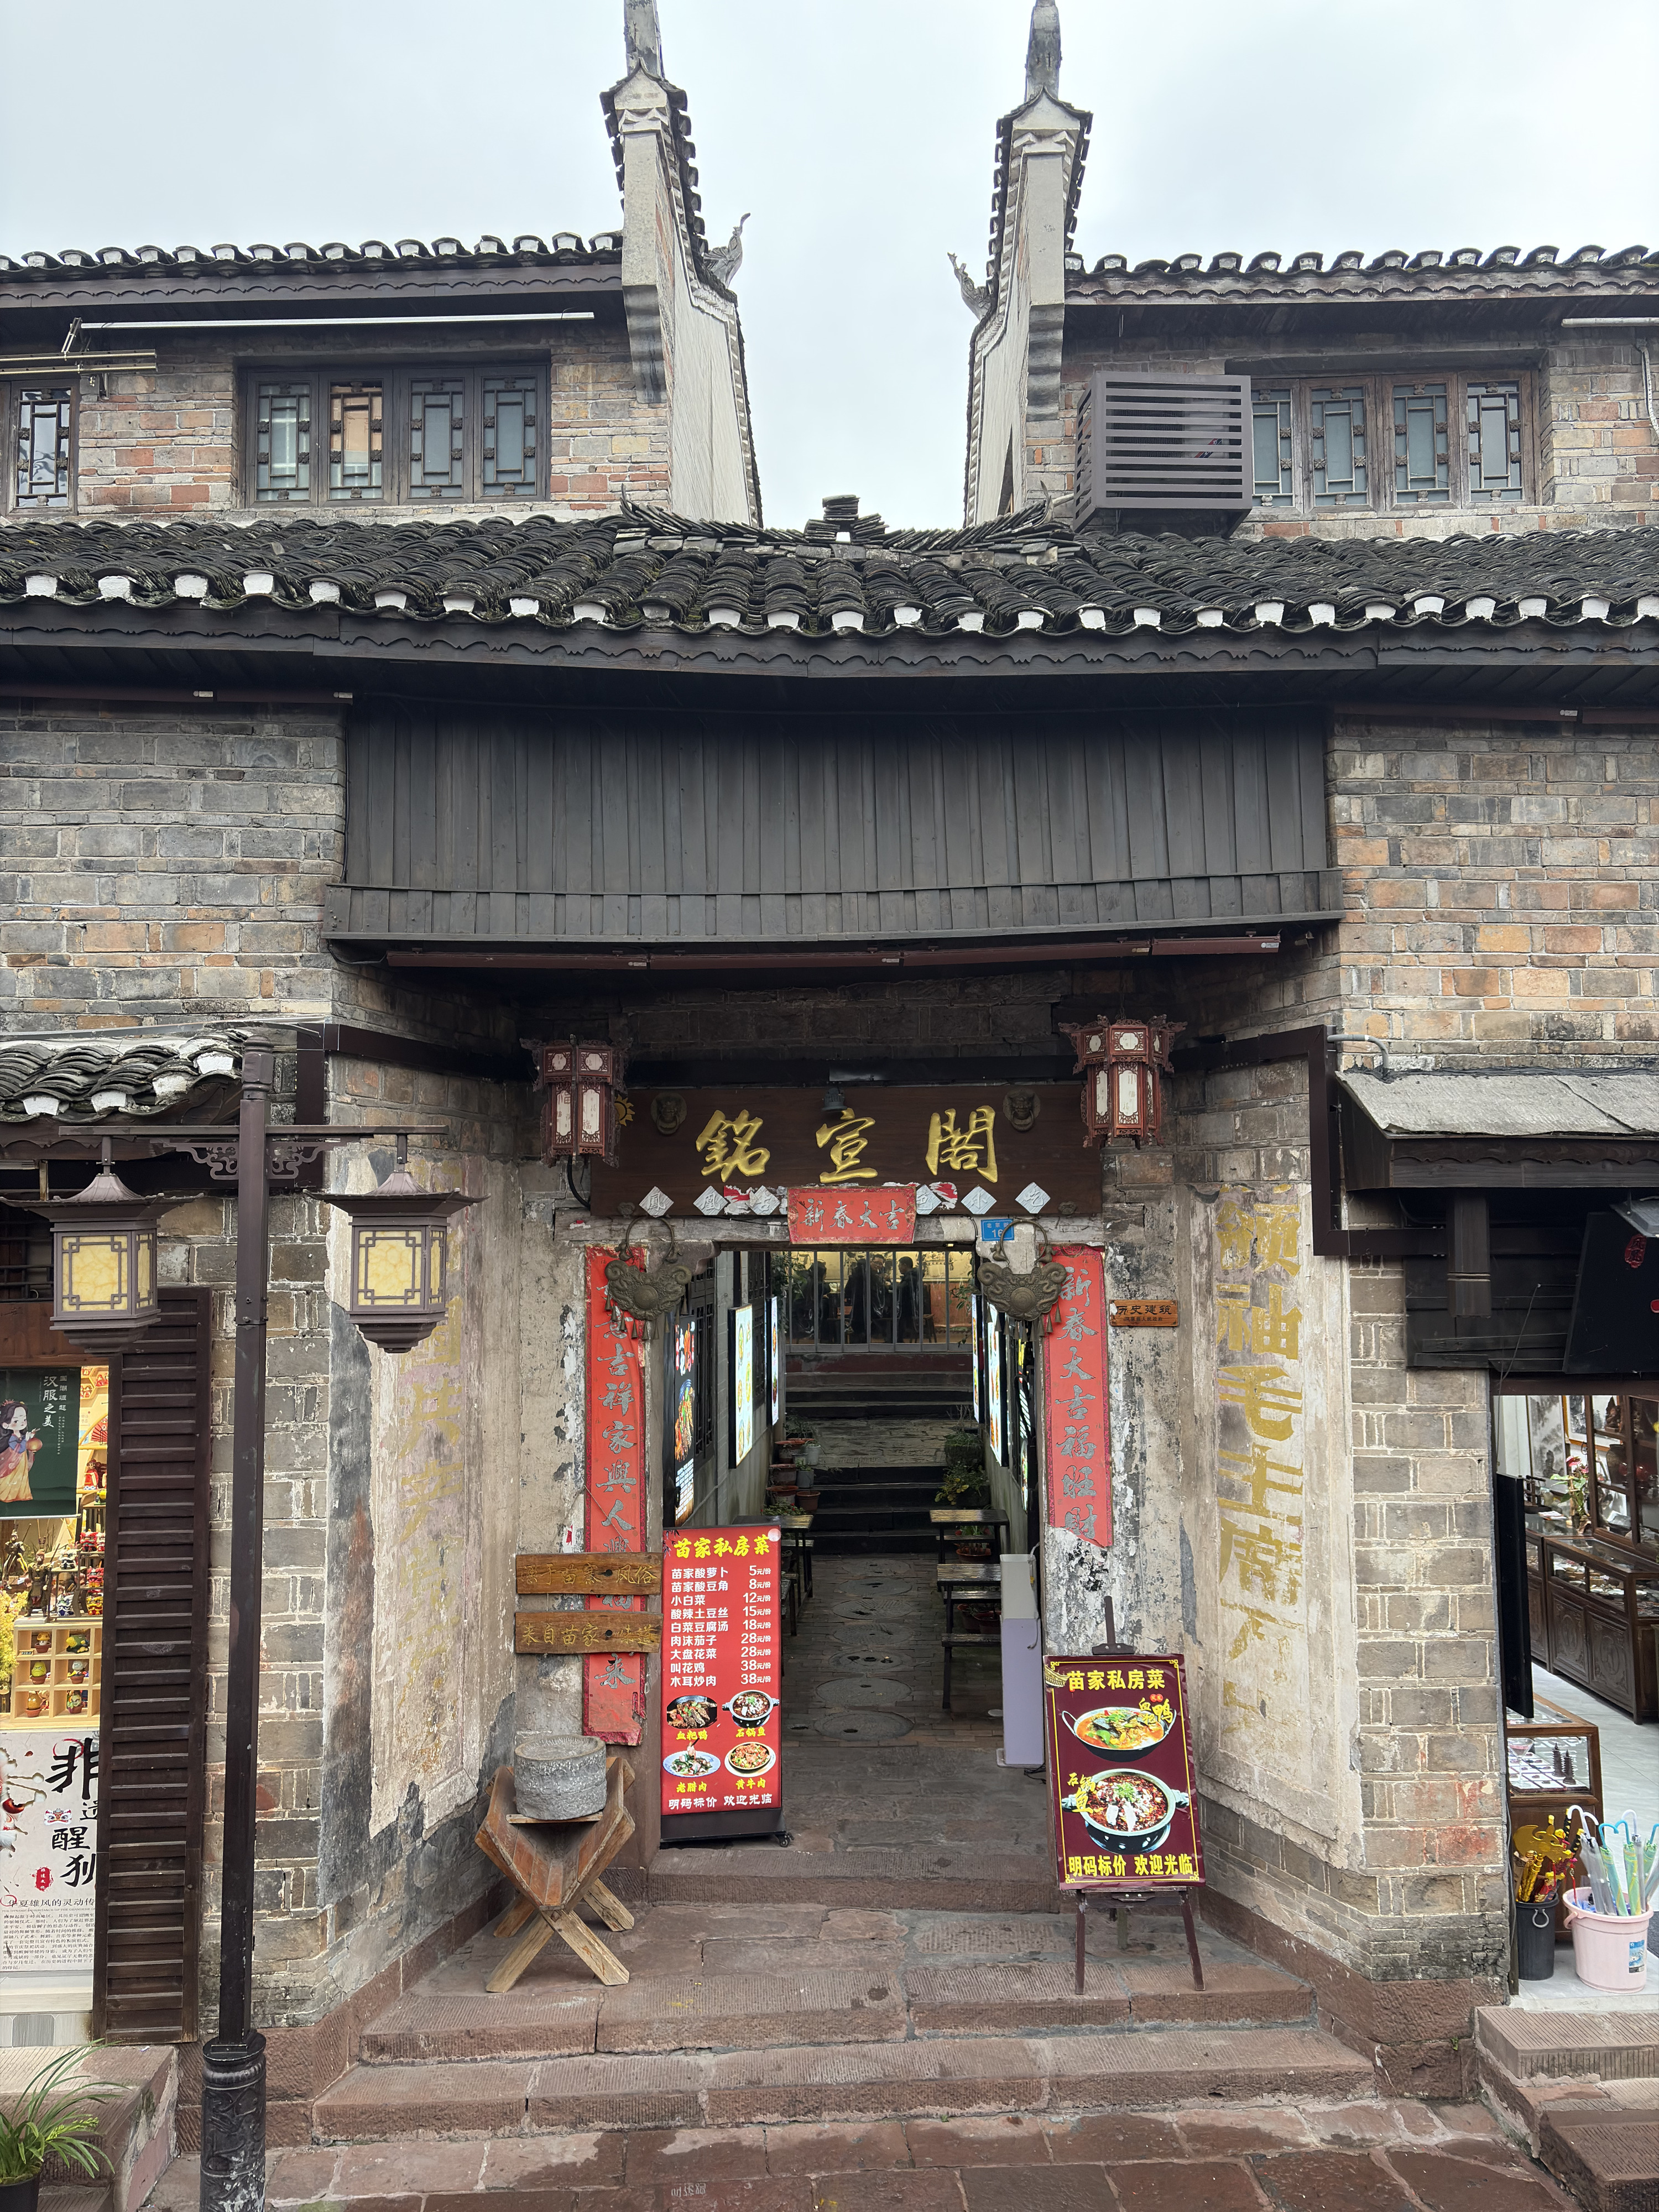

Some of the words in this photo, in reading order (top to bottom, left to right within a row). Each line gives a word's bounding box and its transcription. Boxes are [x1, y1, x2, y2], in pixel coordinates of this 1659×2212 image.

[799, 1198, 905, 1232] 新春大吉
[992, 1229, 1003, 1238] 16
[1116, 1305, 1172, 1315] 历史建筑
[42, 1375, 59, 1428] 汉服之美
[674, 1534, 770, 1559] 苗家私房菜
[671, 1567, 729, 1579] 苗家酸萝卜
[749, 1565, 771, 1576] 5元/份
[671, 1580, 729, 1593] 苗家酸豆角
[749, 1579, 771, 1589] 8元/份
[671, 1594, 706, 1606] 小白菜
[743, 1592, 771, 1603] 12元/份
[671, 1607, 729, 1620] 酸辣土豆丝
[743, 1605, 771, 1617] 15元/份
[671, 1621, 729, 1633] 白菜豆腐汤
[743, 1619, 771, 1630] 18元/份
[670, 1635, 717, 1647] 肉沫茄子
[740, 1633, 771, 1644] 28元/份
[670, 1648, 717, 1660] 大盘花菜
[740, 1646, 771, 1657] 28元/份
[670, 1662, 705, 1674] 叫花鸡
[740, 1660, 771, 1671] 38元/份
[670, 1675, 717, 1687] 木耳炒肉
[740, 1673, 771, 1684] 38元/份
[1067, 1669, 1165, 1691] 苗家私房菜
[735, 1726, 766, 1738] 石锅鱼
[676, 1781, 707, 1793] 老腊肉
[735, 1777, 766, 1790] 黄牛肉
[1067, 1772, 1096, 1815] 石锅鱼
[668, 1796, 717, 1811] 明码标价
[723, 1793, 773, 1806] 欢迎光临
[1068, 1855, 1127, 1877] 明码标价
[1134, 1853, 1194, 1876] 欢迎光临
